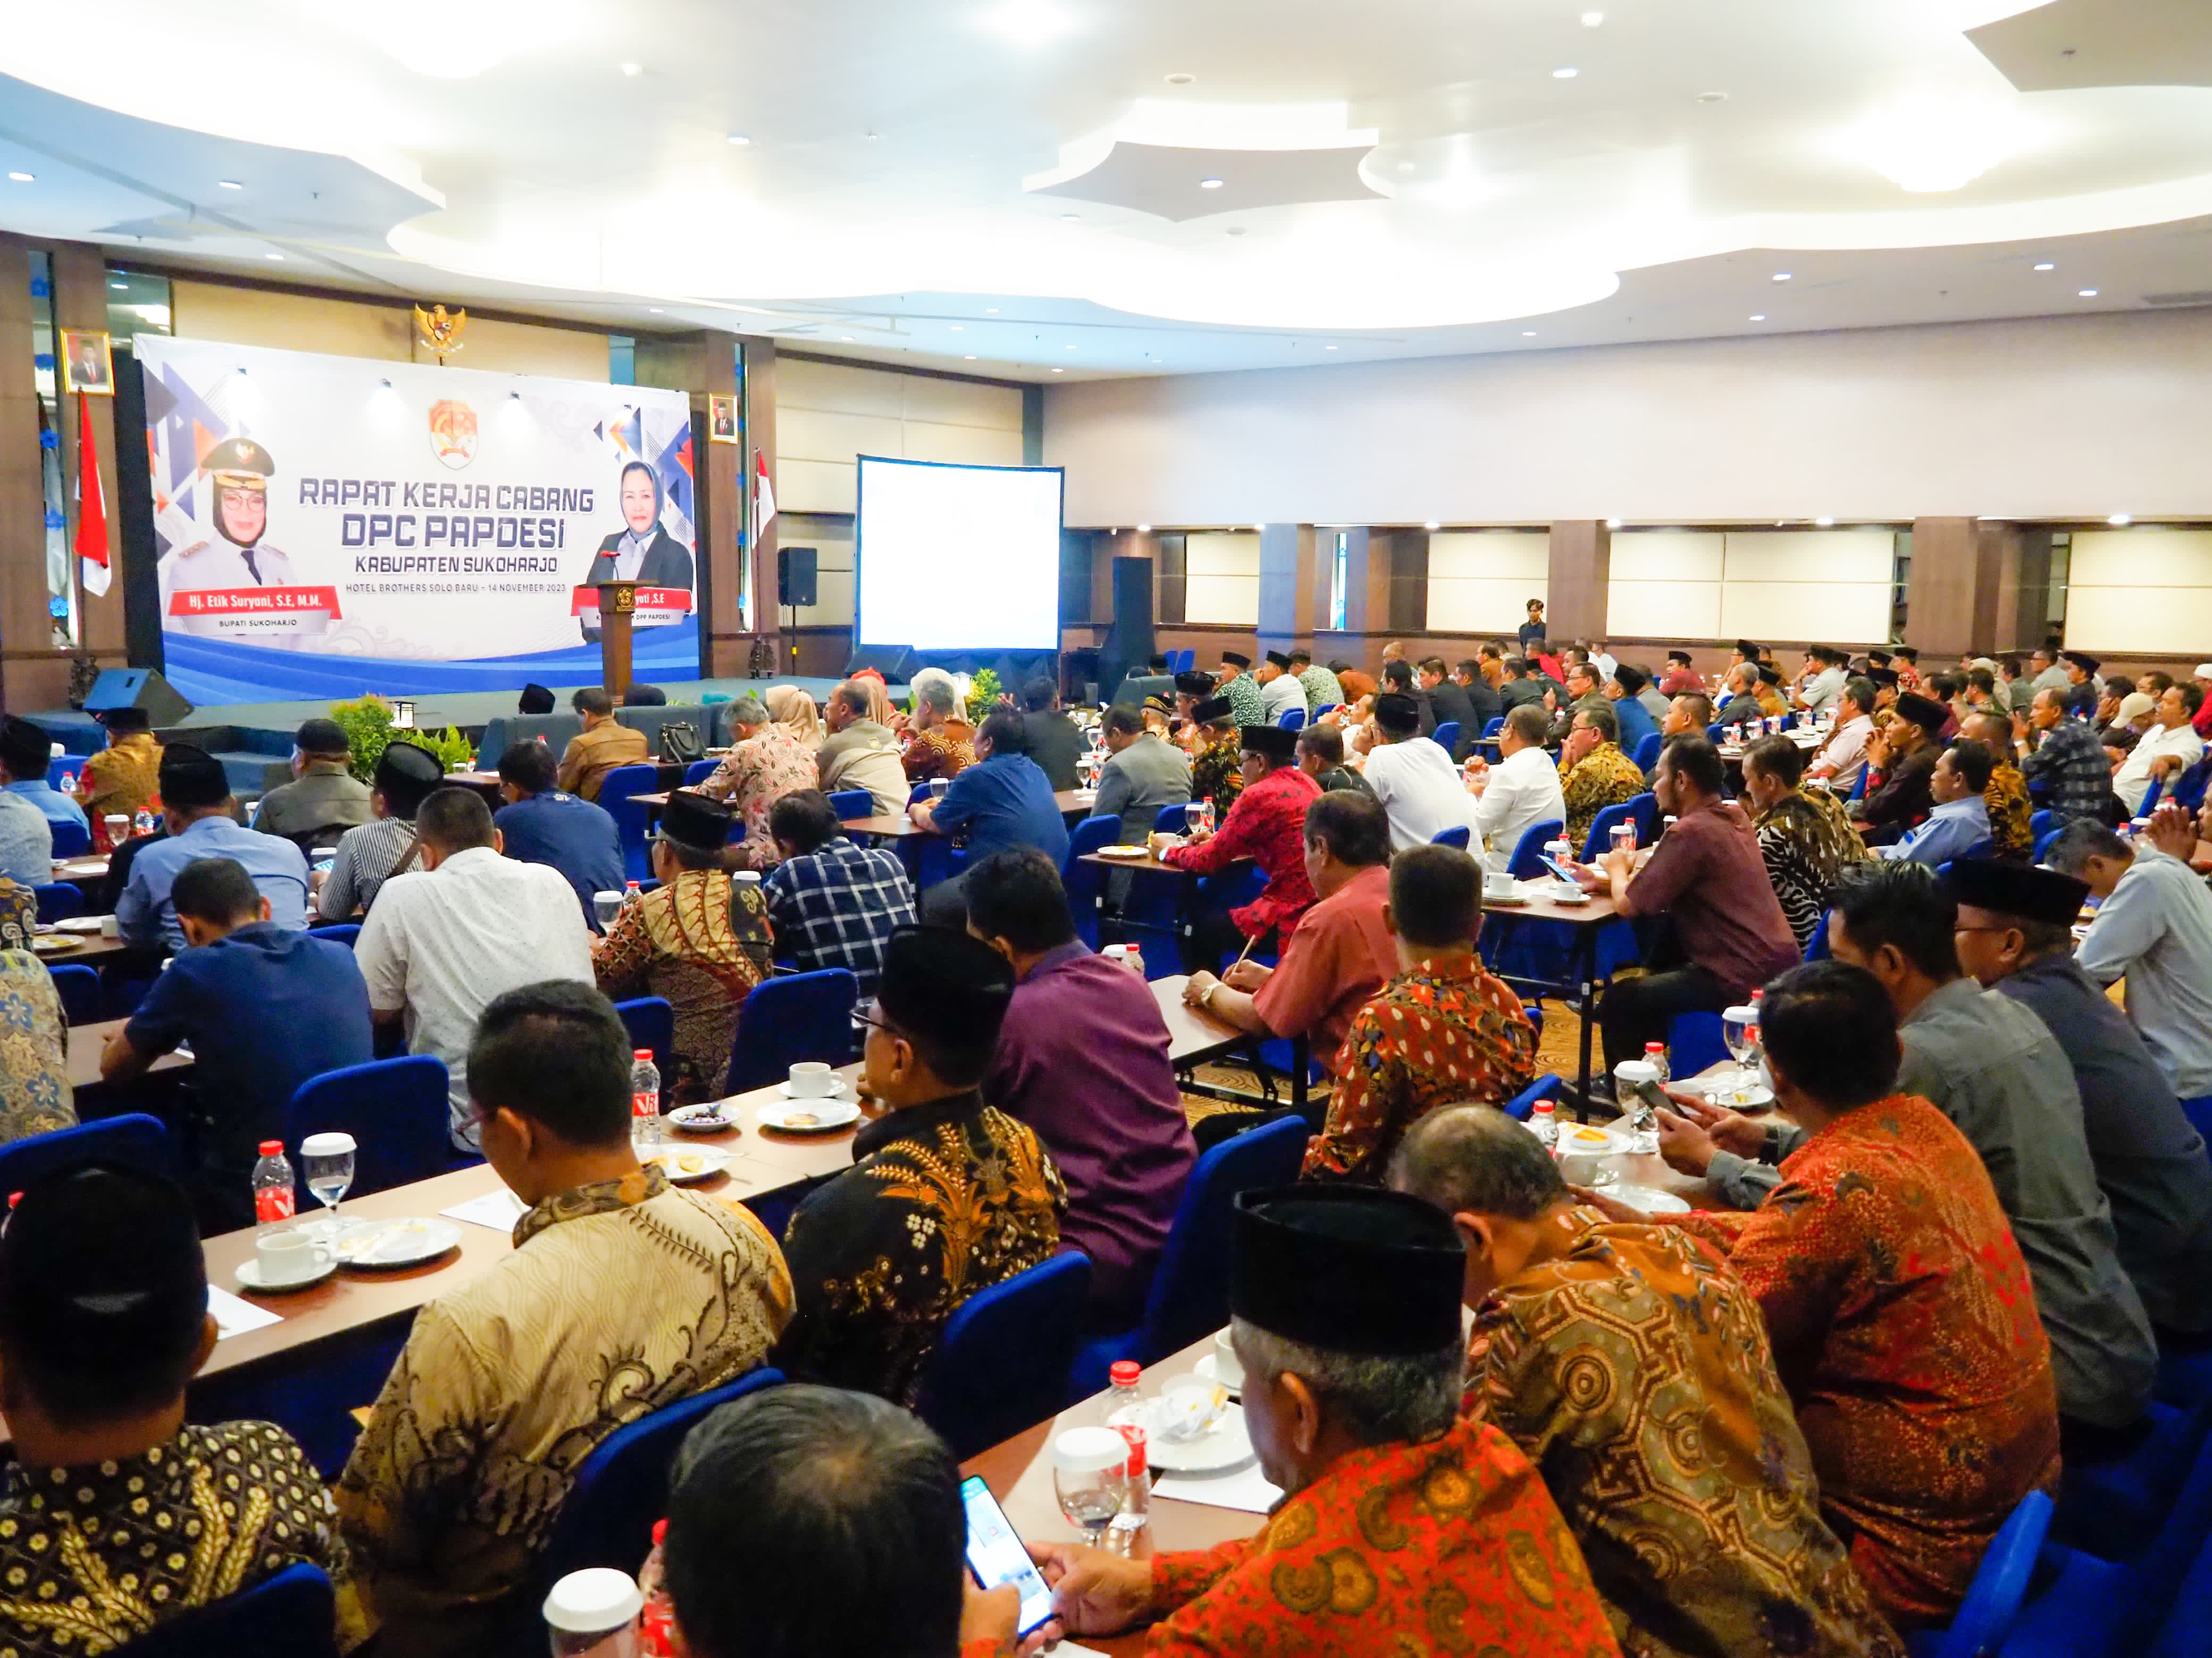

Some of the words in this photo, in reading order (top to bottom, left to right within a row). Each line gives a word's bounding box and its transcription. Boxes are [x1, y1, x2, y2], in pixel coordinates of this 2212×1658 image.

[299, 478, 396, 507] RAPAT
[404, 482, 490, 509] KERJA
[496, 485, 594, 512] CABANG
[341, 513, 416, 546] DPC
[424, 515, 565, 548] PAPDESI
[355, 556, 459, 573] KABUPATEN
[464, 557, 558, 573] SUKOHARJO
[346, 584, 376, 592] HOTEL
[379, 584, 426, 592] BROTHERS
[429, 584, 452, 592] SOLO
[455, 584, 478, 592] BARU
[189, 595, 205, 610] Hj.
[207, 595, 229, 607] Etik
[230, 595, 274, 610] Suryani,
[297, 594, 322, 607] M.M.
[634, 593, 650, 605] yati
